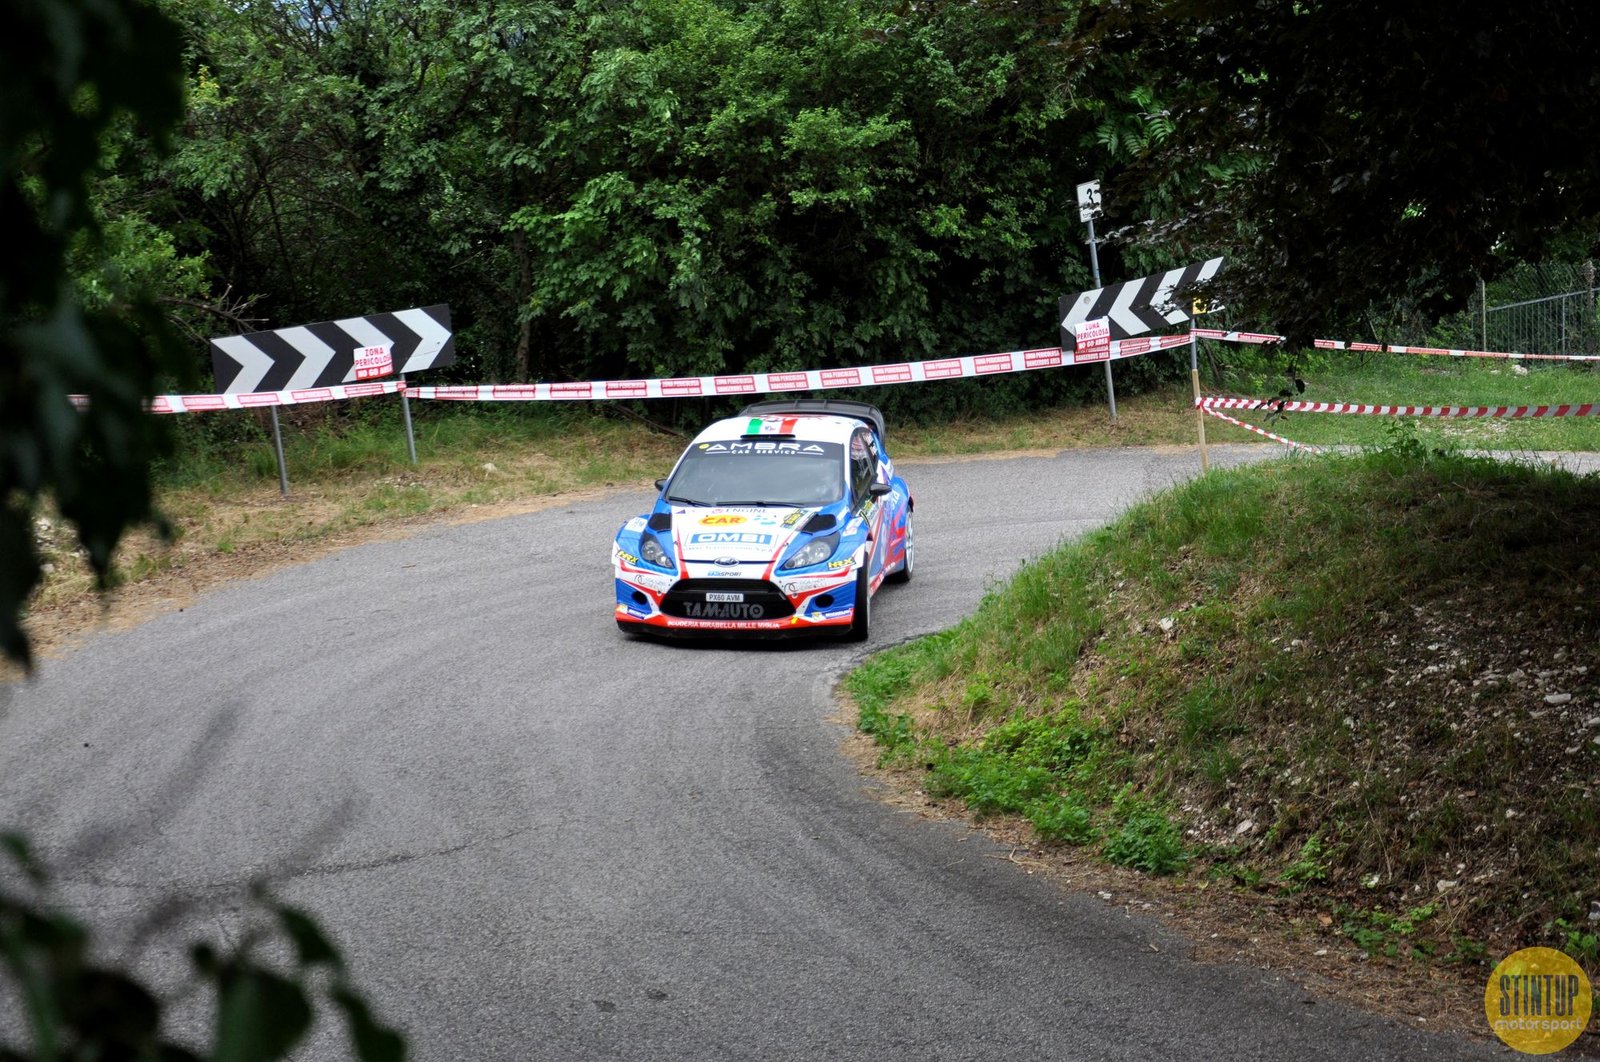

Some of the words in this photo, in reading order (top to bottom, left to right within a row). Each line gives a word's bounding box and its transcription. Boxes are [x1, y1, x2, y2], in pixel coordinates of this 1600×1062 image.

[1077, 327, 1109, 340] PERICOLOSA
[1078, 342, 1086, 350] NO
[1095, 337, 1109, 346] AREA
[365, 347, 384, 357] ZONA
[357, 369, 368, 378] NO
[368, 368, 379, 377] GO
[706, 442, 824, 453] AMBRA
[617, 551, 638, 564] HRX
[828, 558, 853, 568] HRX
